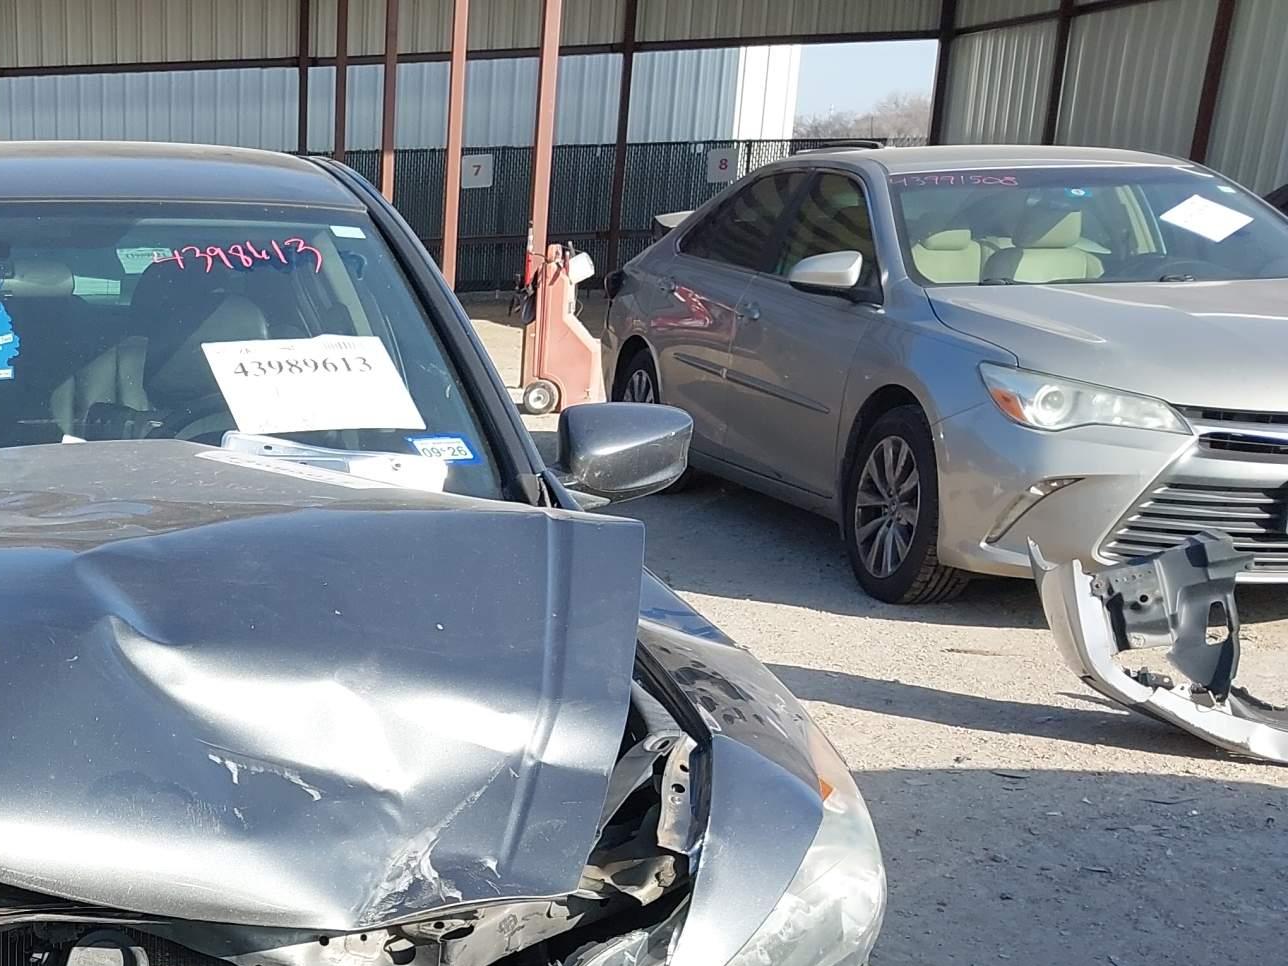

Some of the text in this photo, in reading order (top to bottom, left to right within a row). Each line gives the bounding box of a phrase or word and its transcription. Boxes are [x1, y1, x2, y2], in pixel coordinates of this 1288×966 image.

[472, 164, 481, 176] 7
[719, 158, 728, 170] 8
[233, 356, 373, 377] 43989613
